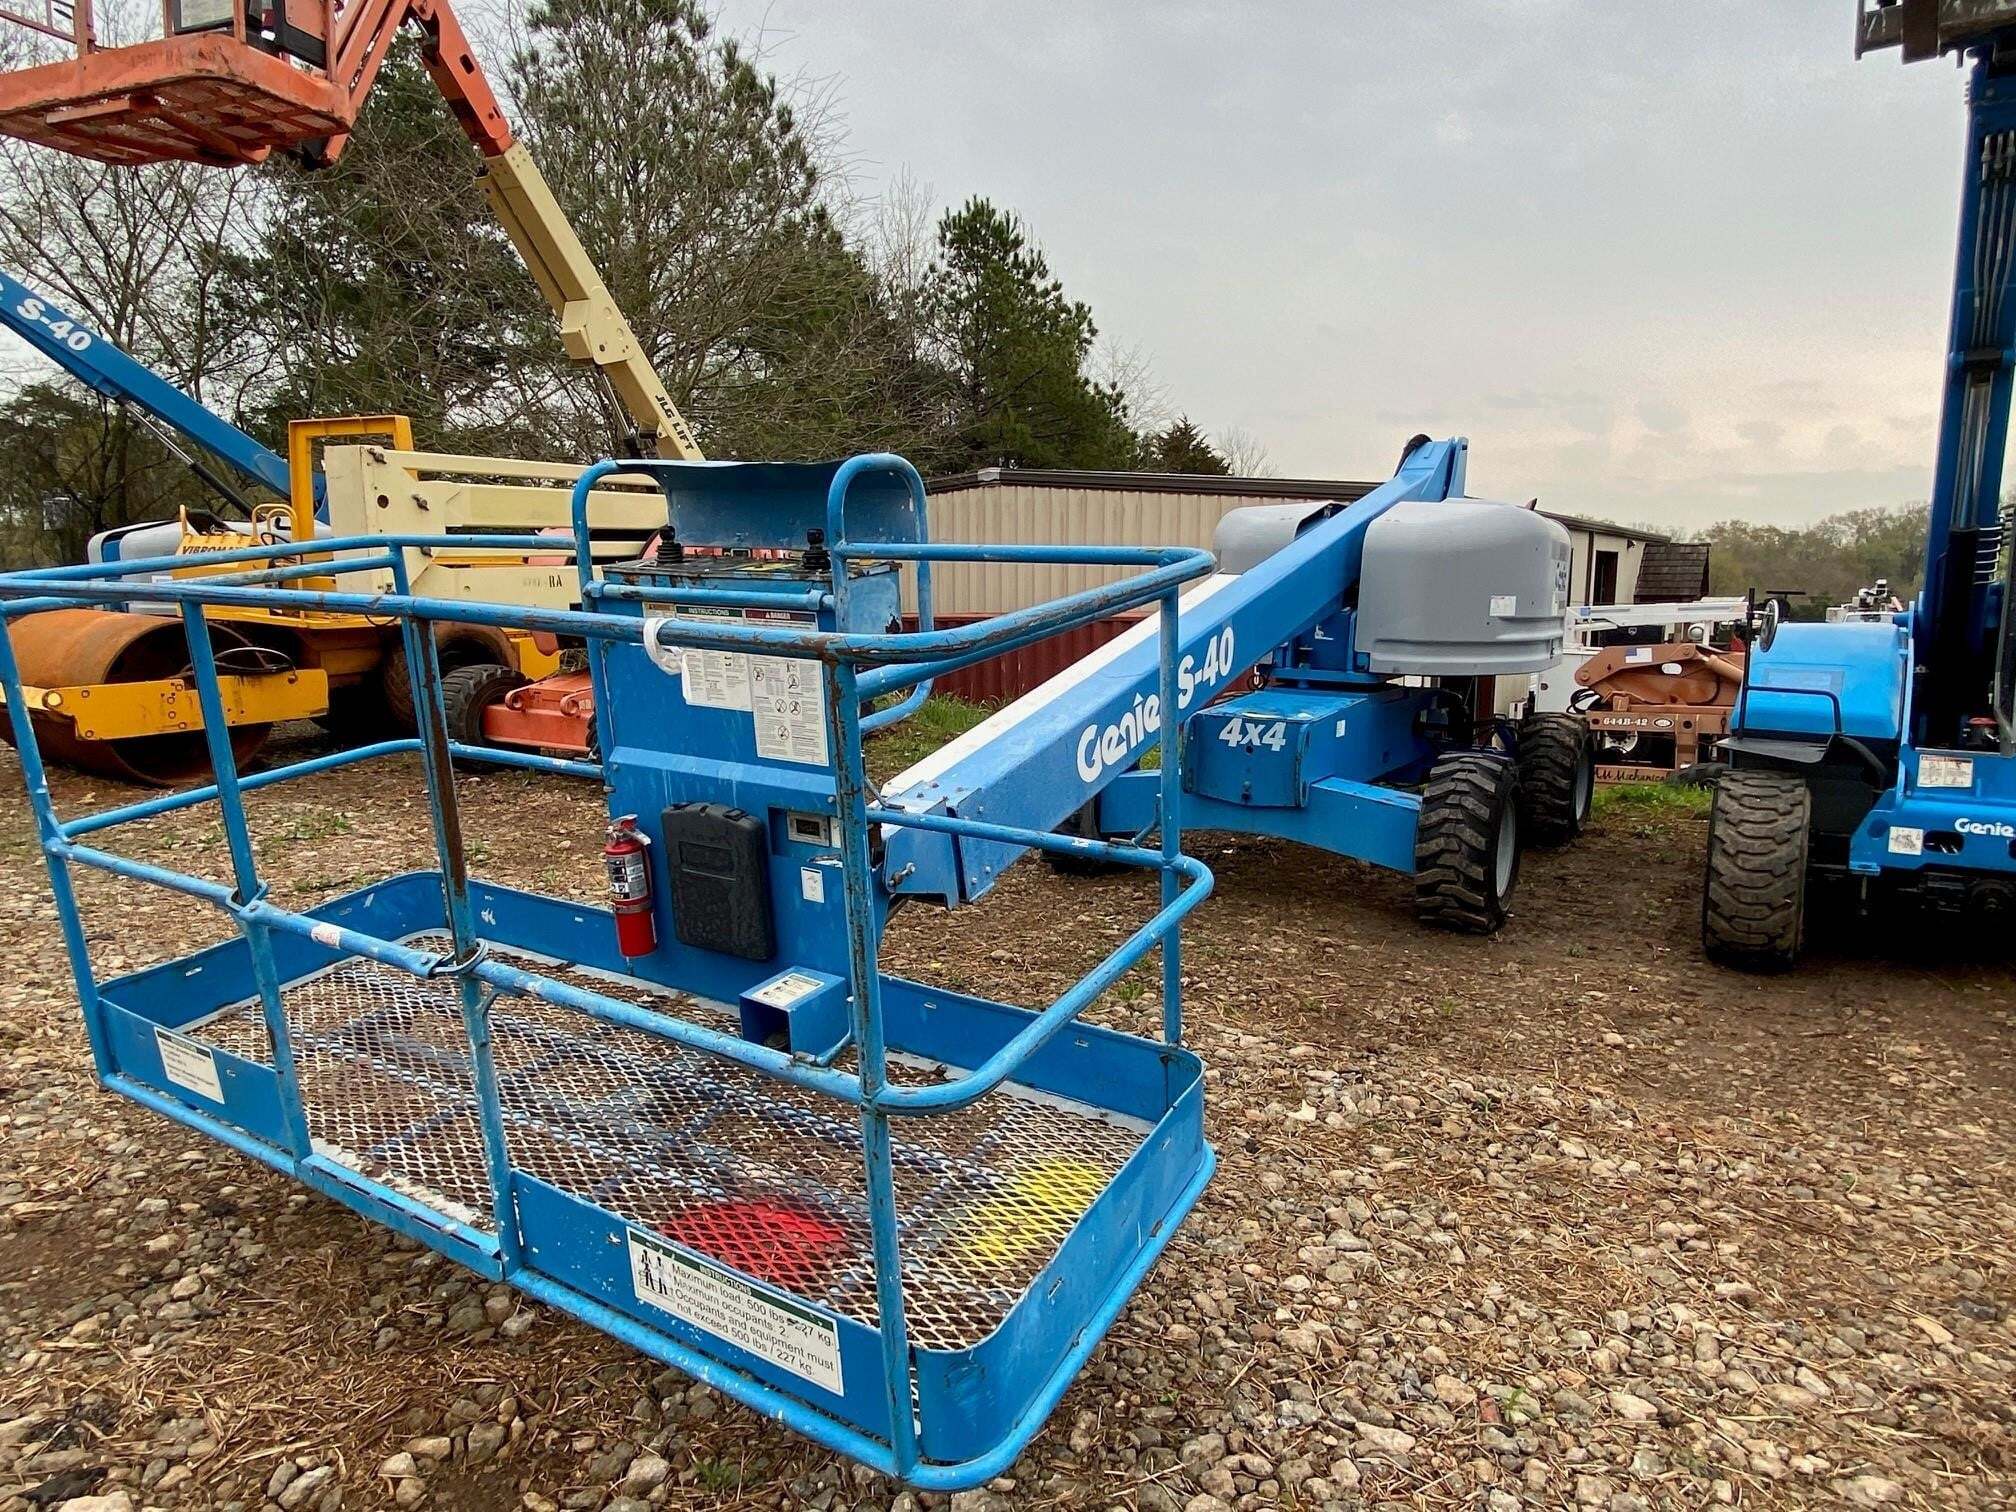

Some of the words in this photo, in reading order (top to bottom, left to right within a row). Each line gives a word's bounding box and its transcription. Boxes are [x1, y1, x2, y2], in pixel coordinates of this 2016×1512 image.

[16, 298, 92, 351] S-40
[655, 395, 675, 418] JLG
[673, 422, 694, 449] LIFT
[687, 607, 730, 616] INSTRUCTIONS
[1077, 692, 1160, 782] Genie
[1177, 626, 1235, 709] S-40
[1219, 717, 1287, 752] 4x4
[1954, 817, 2015, 837] Genie
[672, 1264, 717, 1293] Maximum
[747, 1299, 766, 1315] 500
[769, 1309, 785, 1323] lbs
[674, 1276, 719, 1305] Maximum
[675, 1288, 726, 1321] Occupants
[729, 1316, 747, 1330] and
[750, 1326, 805, 1358] equipment
[807, 1352, 834, 1372] must
[677, 1303, 692, 1316] not
[694, 1311, 729, 1333] exceed
[731, 1327, 750, 1343] 500
[752, 1337, 768, 1352] lbs
[776, 1348, 795, 1364] 227
